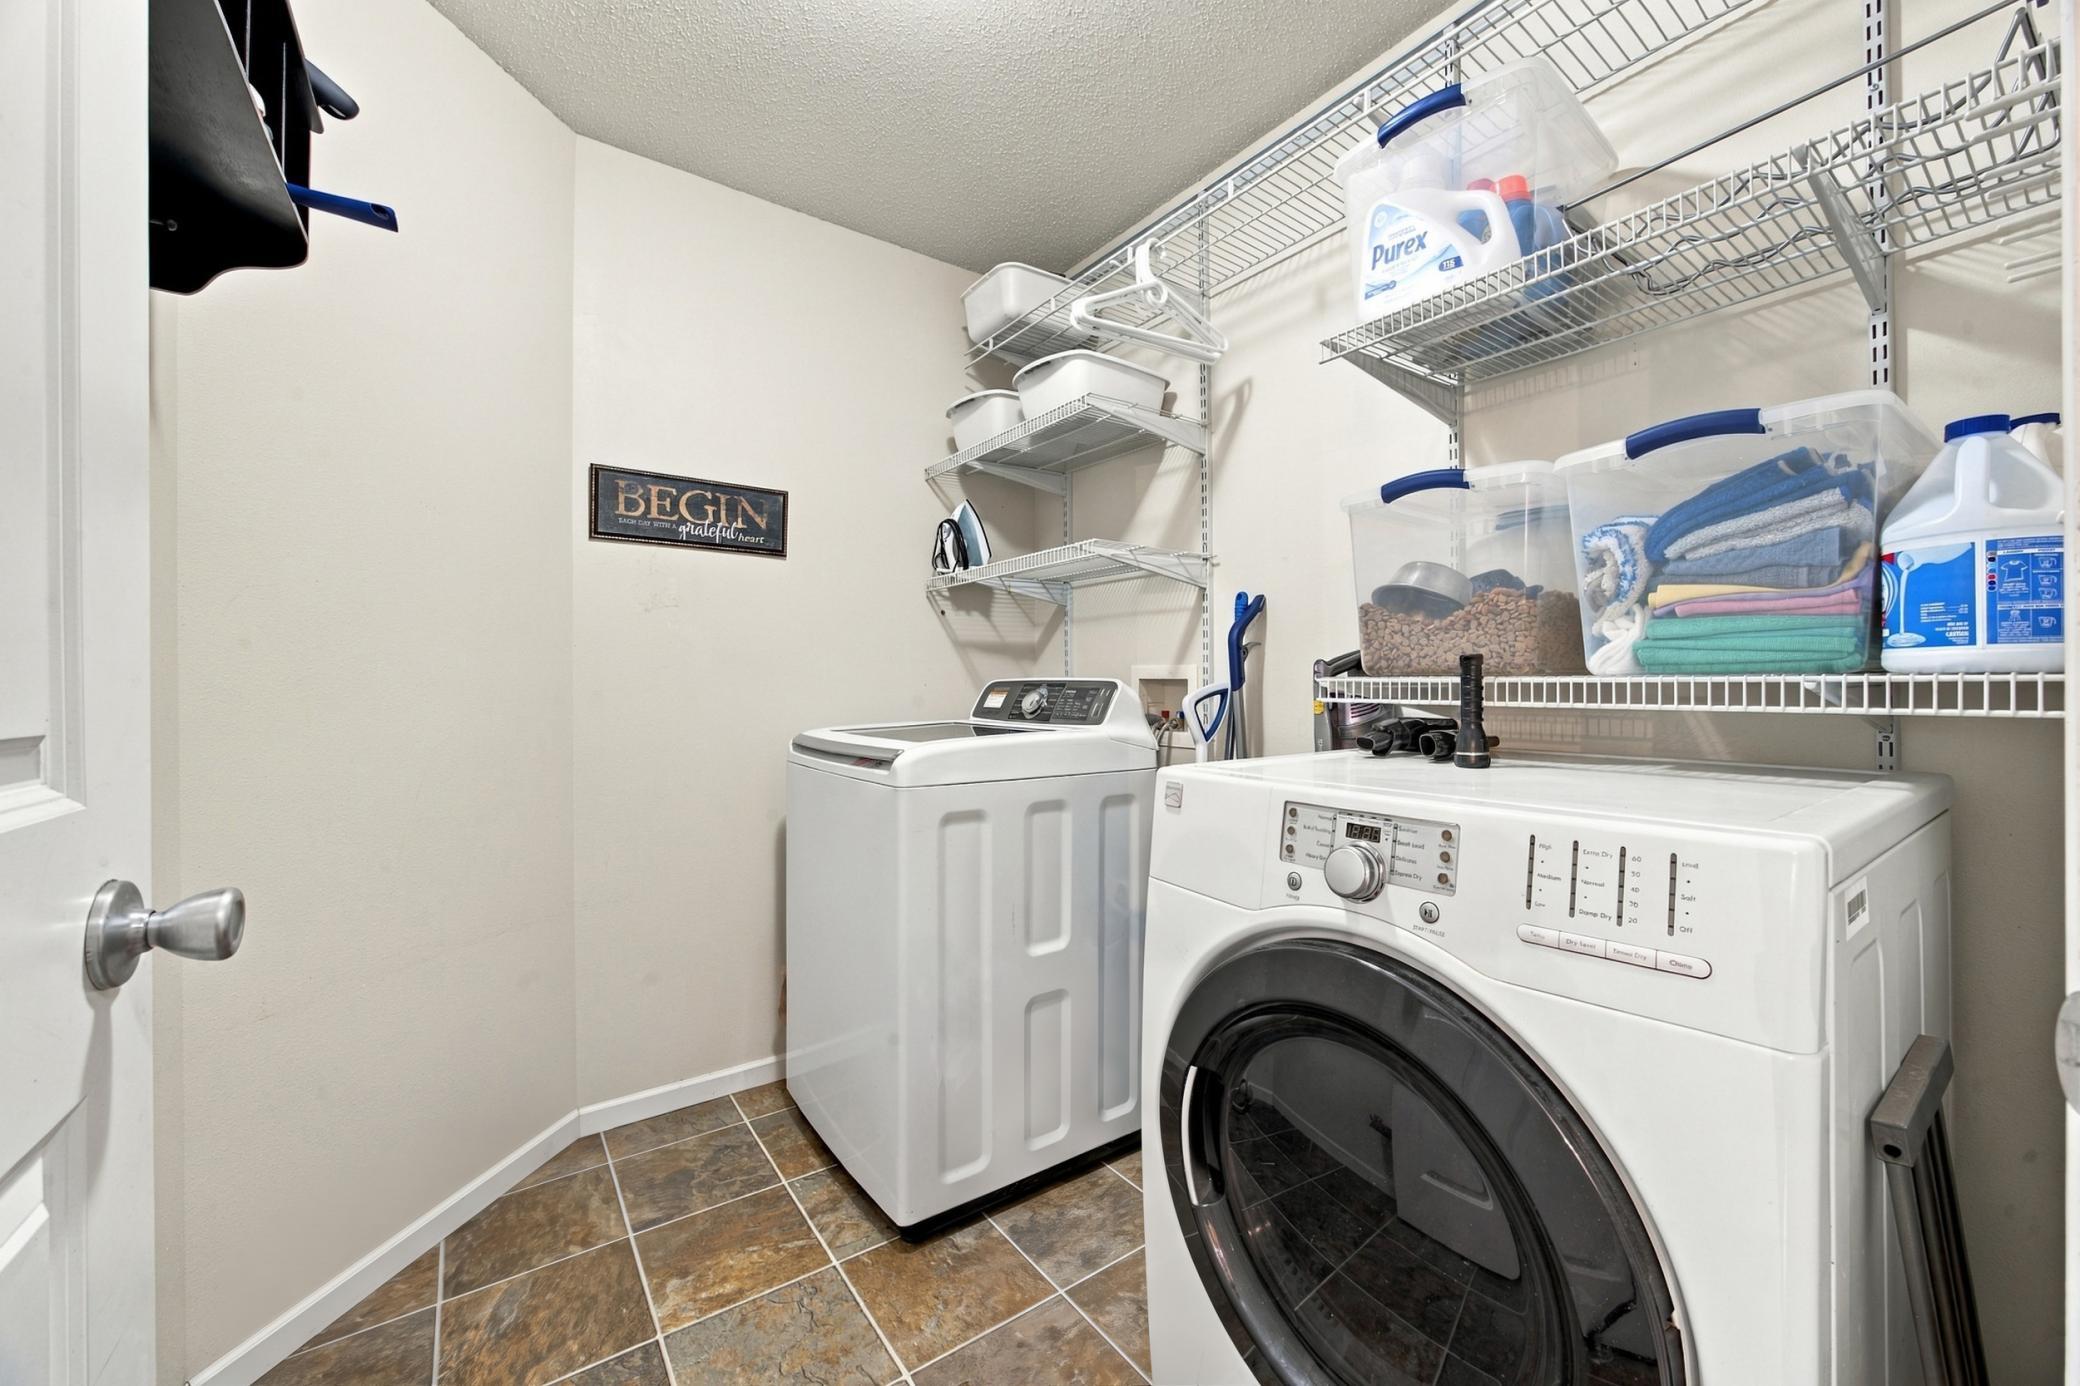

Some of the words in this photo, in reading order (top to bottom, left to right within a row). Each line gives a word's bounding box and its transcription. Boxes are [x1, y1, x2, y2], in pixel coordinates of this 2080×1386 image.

[1372, 231, 1428, 271] Purex
[614, 479, 767, 529] BEGIN
[653, 521, 671, 529] WITH
[678, 520, 738, 543] grateful
[738, 532, 765, 544] heart
[1631, 855, 1642, 863] 60
[1599, 911, 1612, 921] Dry
